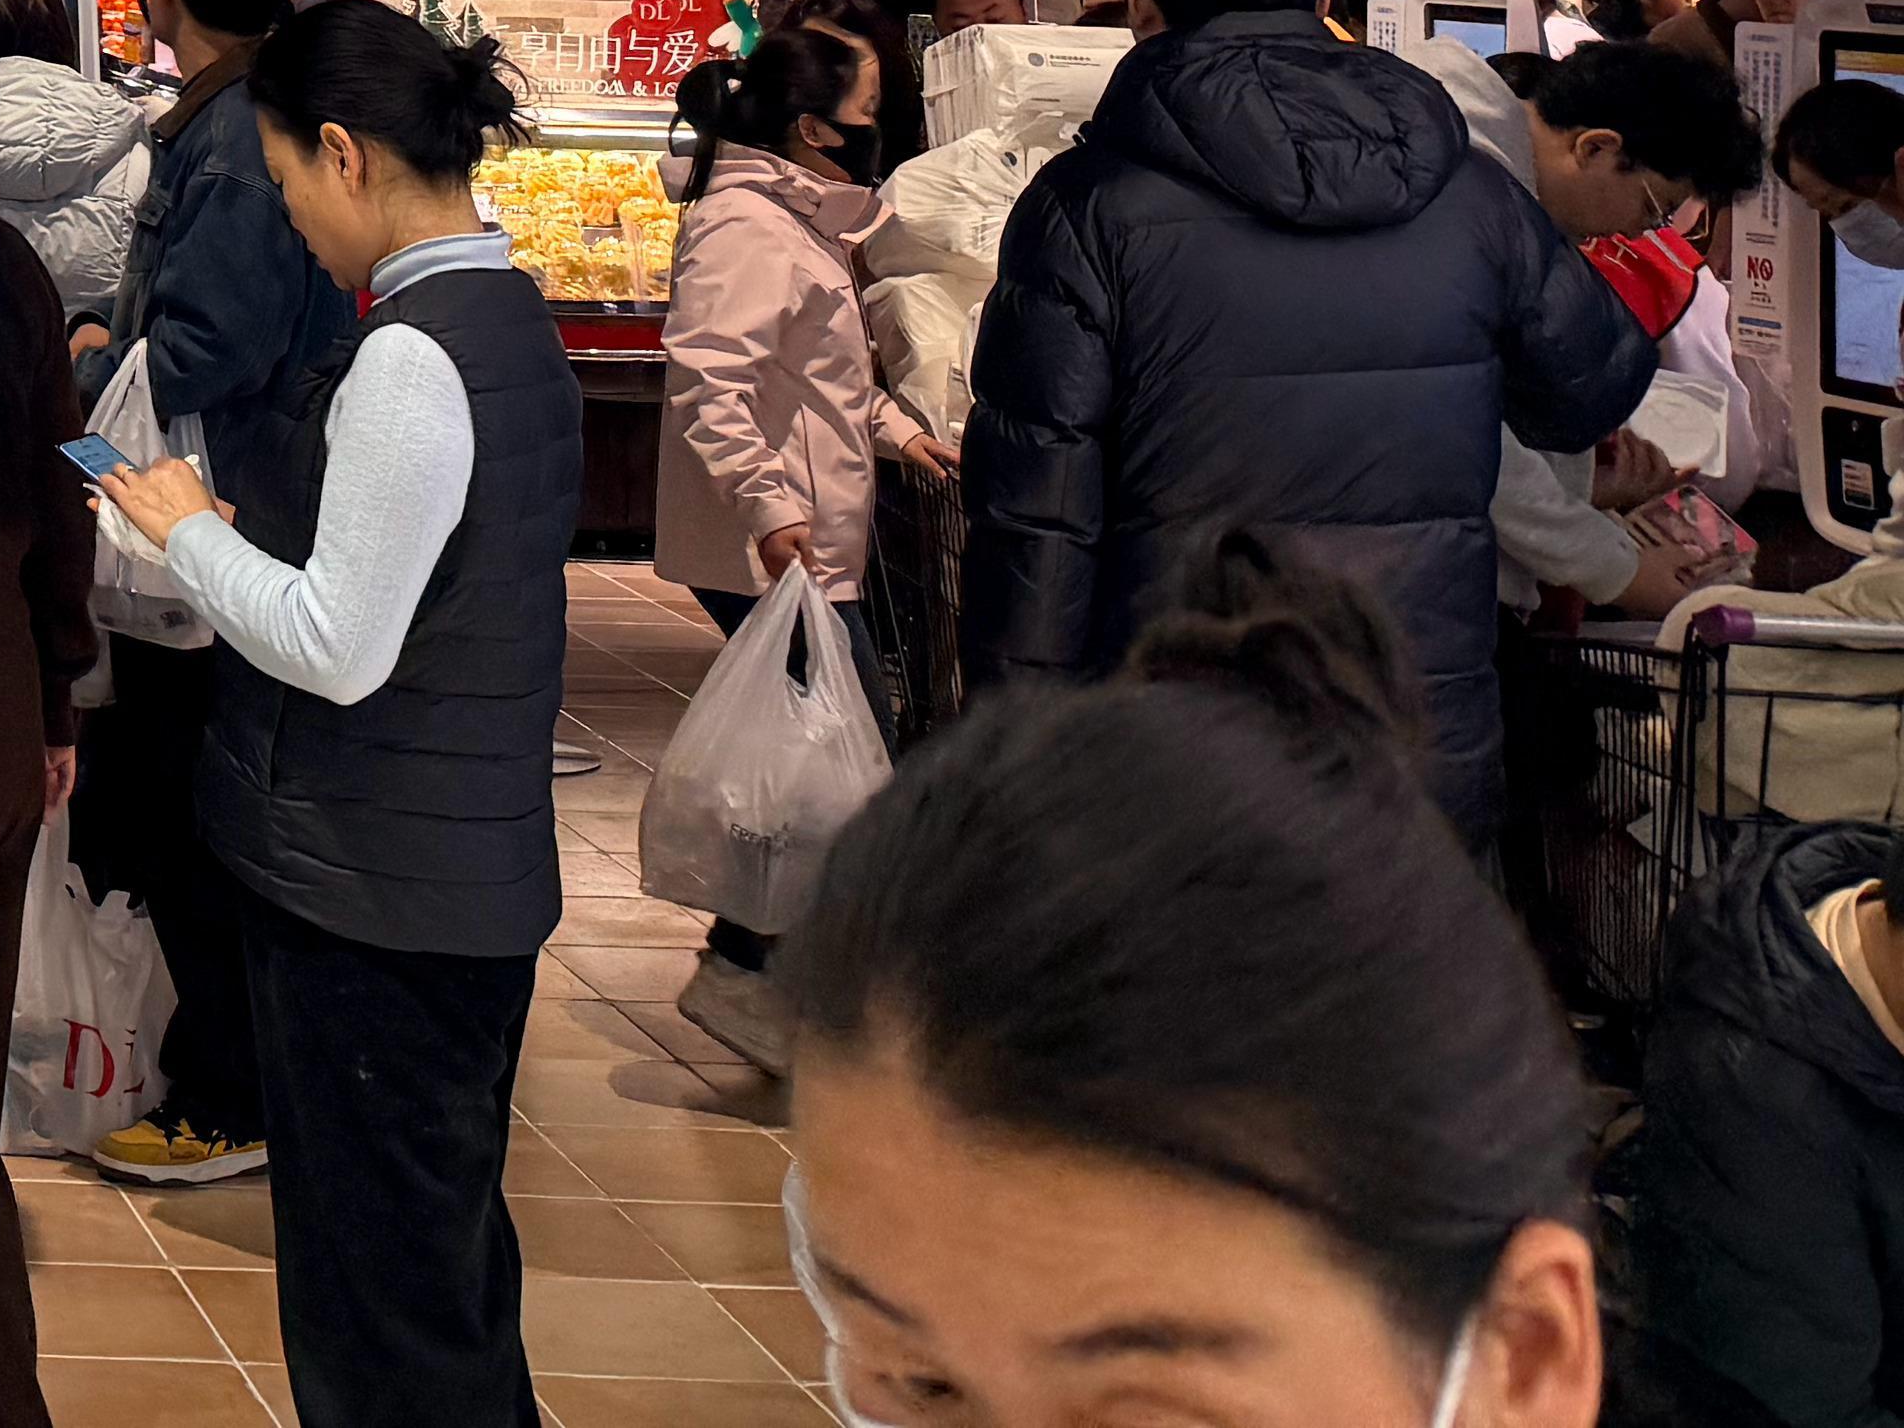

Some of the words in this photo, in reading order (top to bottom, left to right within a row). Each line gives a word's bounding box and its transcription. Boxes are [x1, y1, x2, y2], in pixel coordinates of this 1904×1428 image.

[492, 24, 699, 76] 享自由与爱
[632, 80, 648, 97] &
[654, 80, 677, 97] LO
